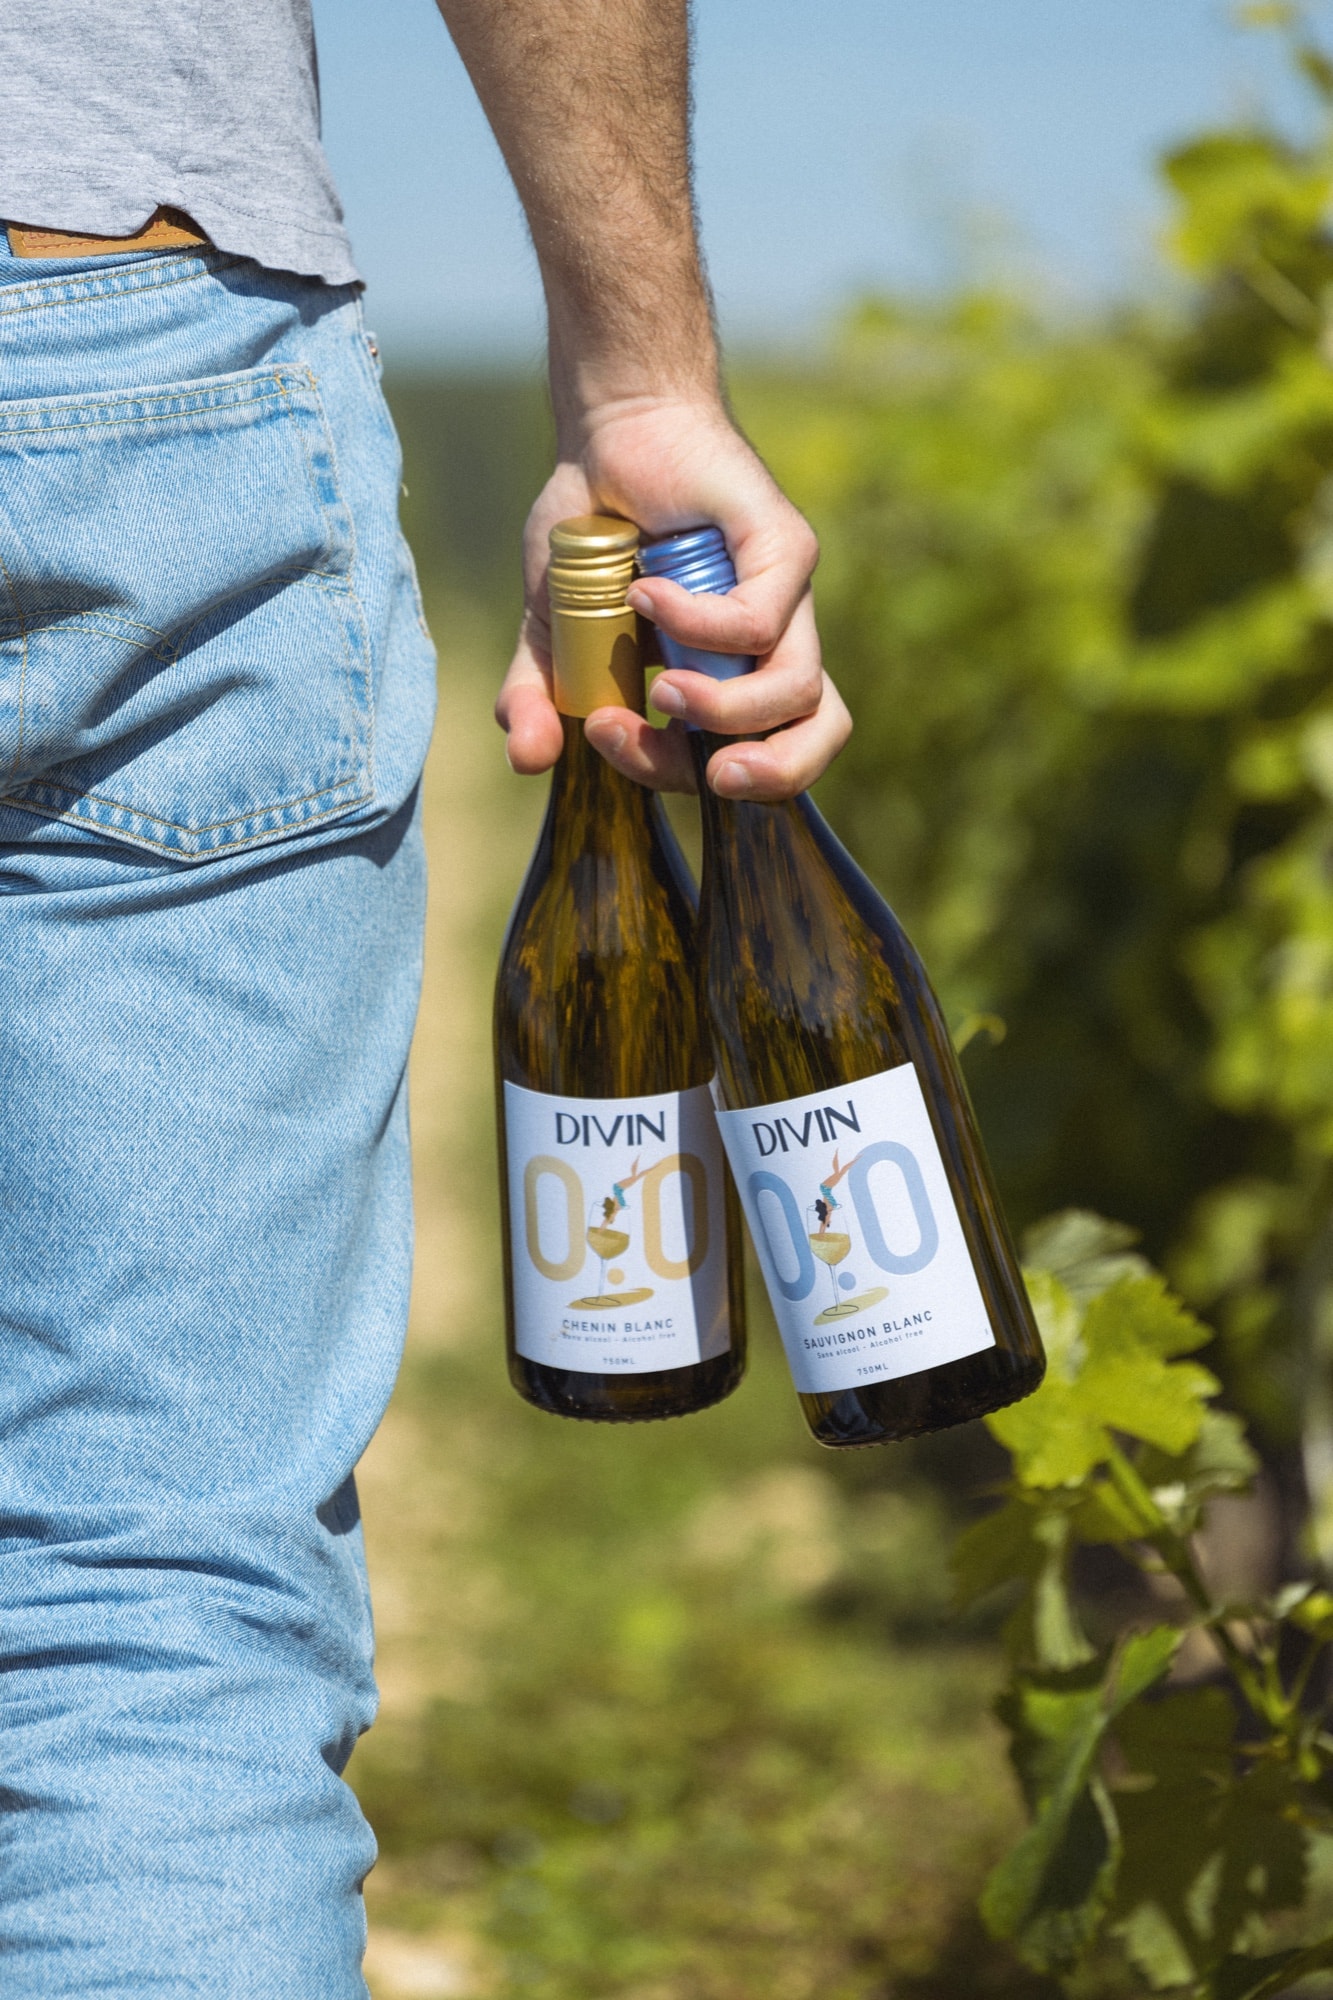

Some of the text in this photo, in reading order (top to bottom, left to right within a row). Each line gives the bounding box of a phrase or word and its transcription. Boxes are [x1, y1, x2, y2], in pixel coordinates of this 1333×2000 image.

[555, 1111, 666, 1147] DIVIN
[752, 1100, 861, 1157] DIVIN
[562, 1318, 674, 1333] CHENIN BLANC
[803, 1310, 933, 1350] SAUVIGNON BLANC
[816, 1351, 834, 1359] Sans
[836, 1345, 861, 1356] alcool
[870, 1335, 903, 1349] Alcohol
[905, 1329, 924, 1340] free
[602, 1357, 636, 1366] 750ML
[856, 1363, 889, 1376] 750ML
